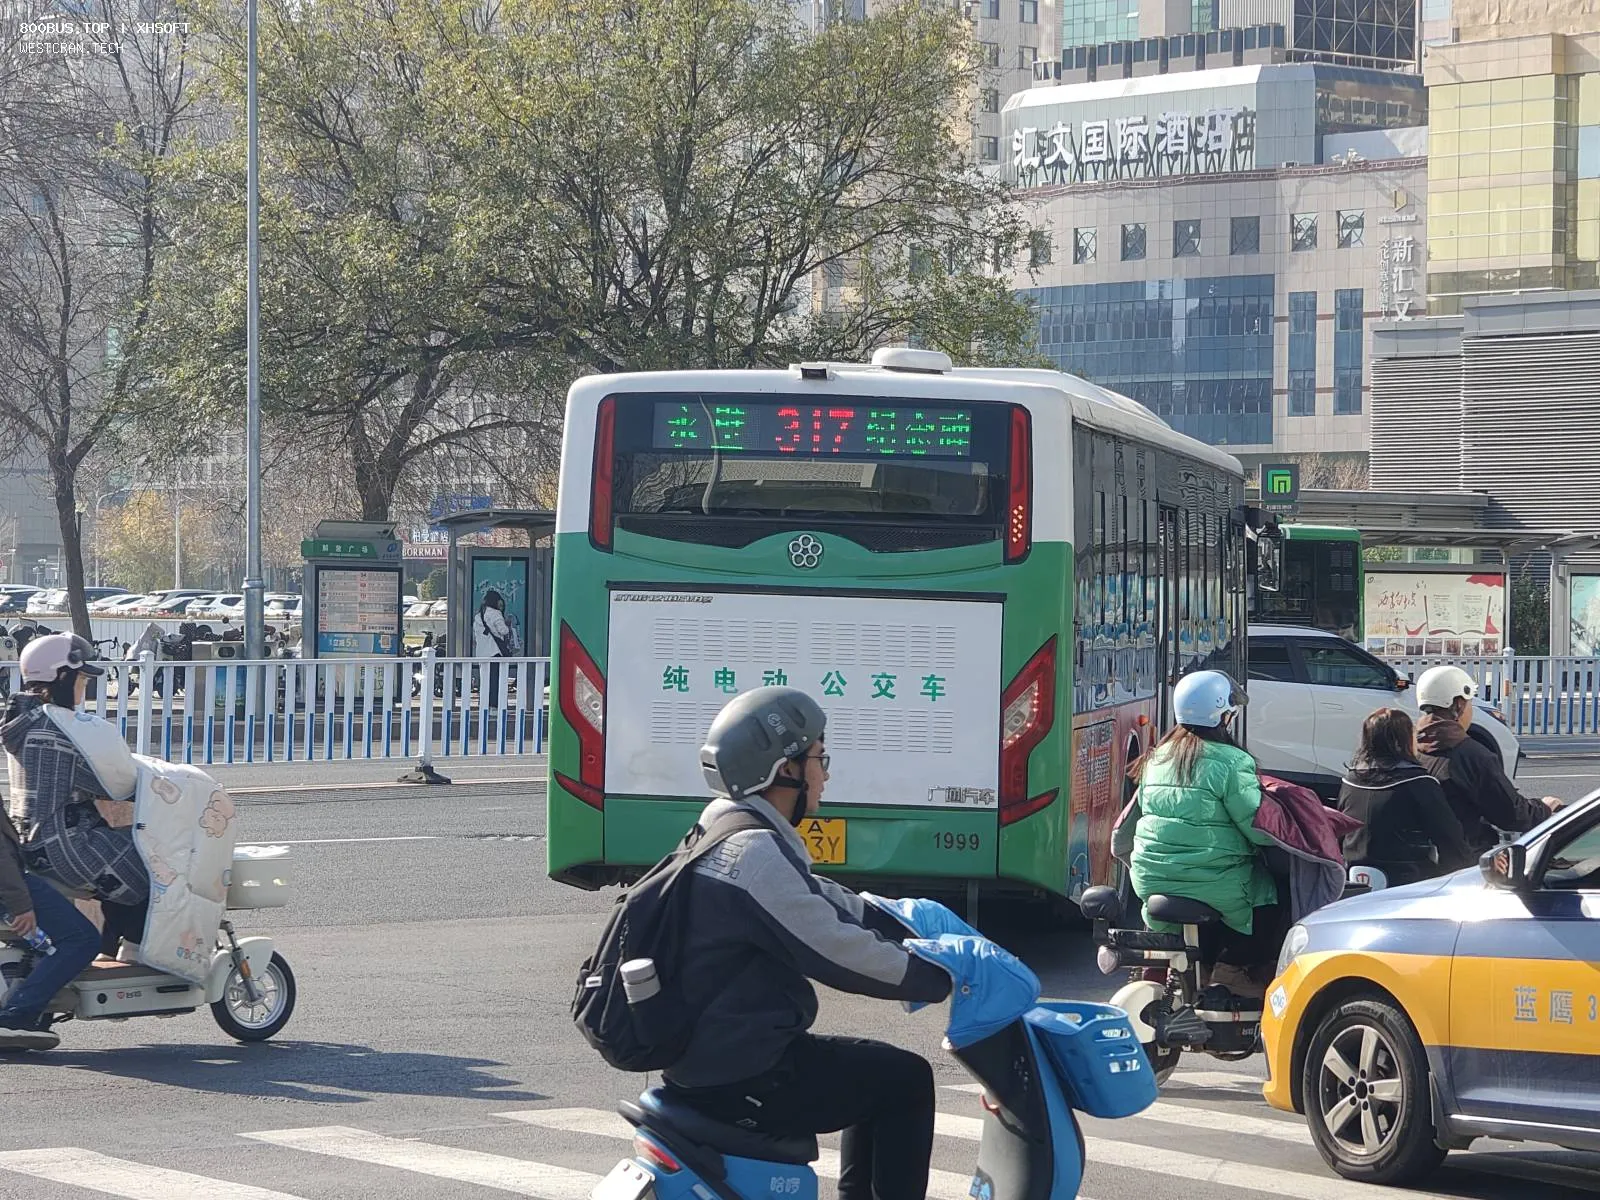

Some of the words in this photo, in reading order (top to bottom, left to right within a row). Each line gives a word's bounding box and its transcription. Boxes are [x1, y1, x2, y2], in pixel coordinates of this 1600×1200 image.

[1012, 106, 1237, 169] 汇文国际酒店
[1391, 235, 1415, 321] 新汇文
[775, 408, 856, 454] 317
[662, 664, 947, 702] 纯电动公交车
[933, 831, 980, 851] 1999
[1513, 985, 1573, 1025] 蓝鹰
